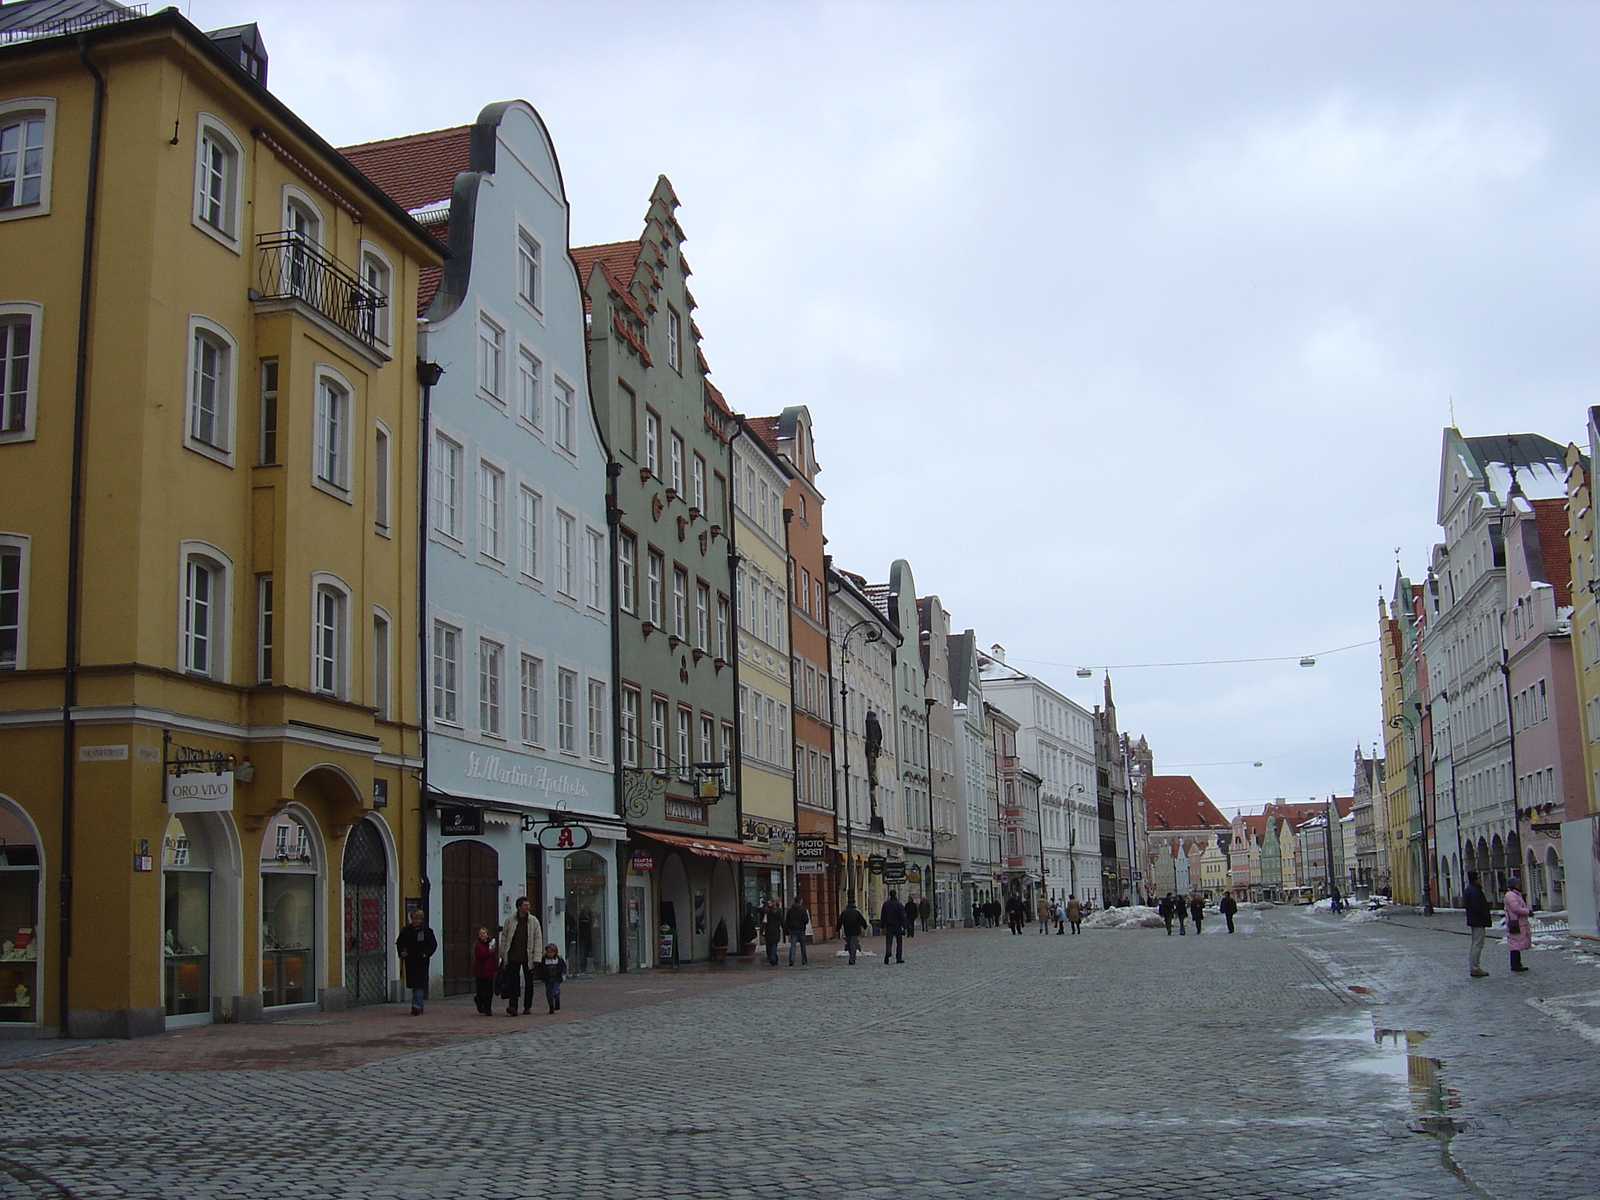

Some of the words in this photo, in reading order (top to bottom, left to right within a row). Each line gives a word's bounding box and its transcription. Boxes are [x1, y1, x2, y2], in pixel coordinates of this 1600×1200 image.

[172, 785, 198, 797] ORO
[201, 783, 228, 796] VIVO
[557, 827, 574, 848] A
[797, 840, 824, 848] PHOTO
[797, 848, 823, 856] PORST
